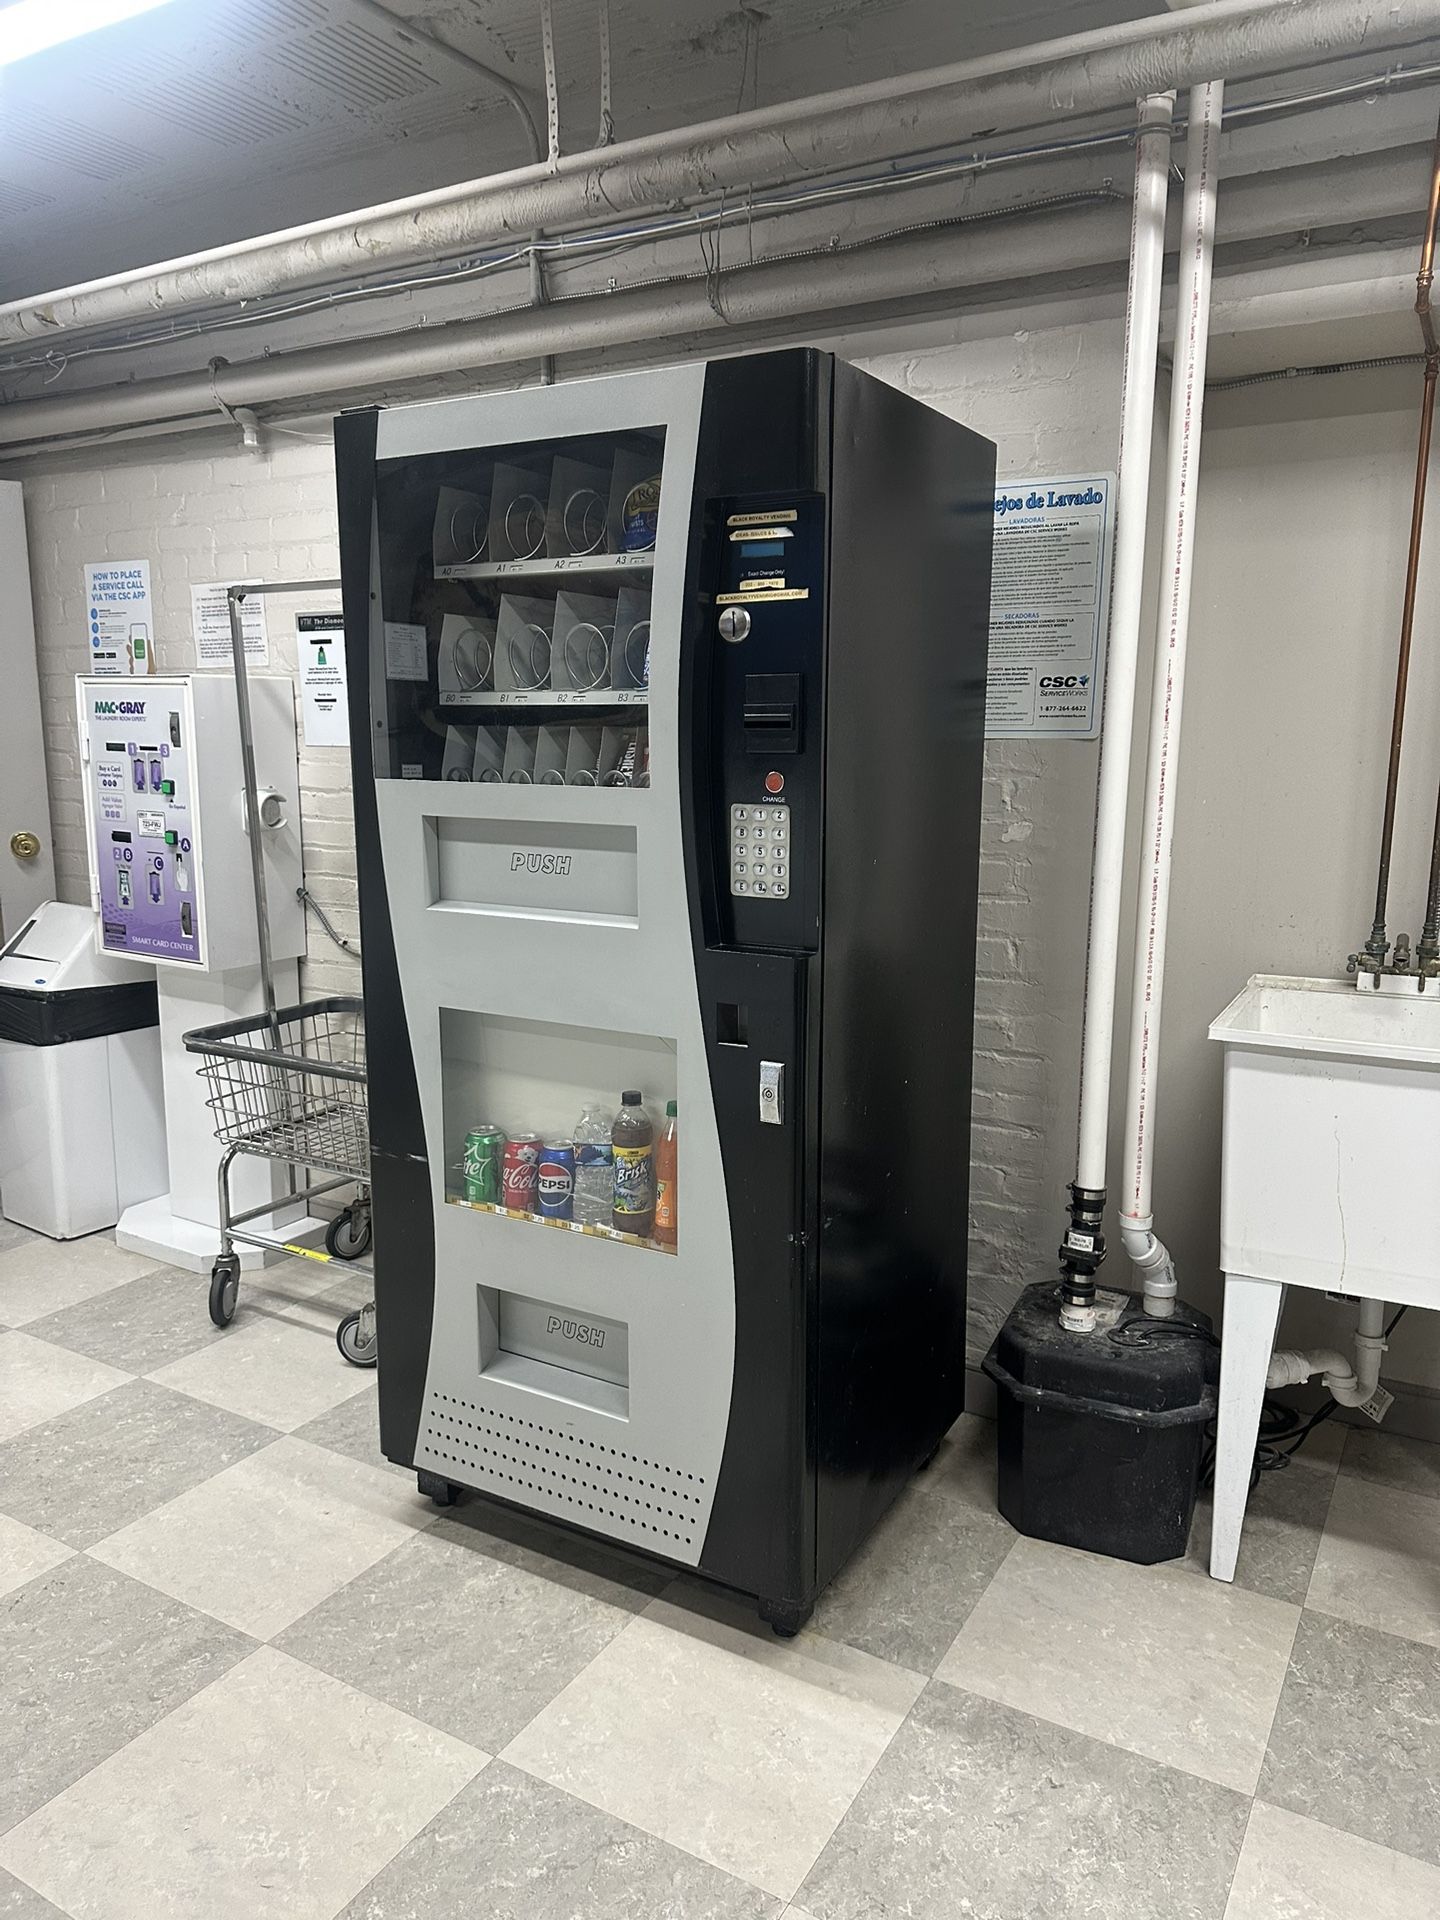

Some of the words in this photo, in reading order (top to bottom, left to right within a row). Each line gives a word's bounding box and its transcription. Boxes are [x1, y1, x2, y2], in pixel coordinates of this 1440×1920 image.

[1026, 492, 1045, 509] de
[1046, 487, 1103, 507] Lavado
[1009, 517, 1045, 525] LAVADORAS
[496, 564, 506, 573] A1
[554, 560, 565, 569] A2
[615, 556, 627, 565] A3
[93, 572, 109, 582] HOW
[110, 571, 119, 580] TO
[120, 570, 142, 580] PLACE
[92, 583, 97, 591] A
[98, 582, 125, 591] SERVICE
[126, 580, 144, 590] CALL
[91, 593, 103, 602] VIA
[104, 592, 117, 602] THE
[118, 592, 131, 601] CSC
[132, 591, 146, 600] APP
[1004, 612, 1040, 620] SECADORAS
[1039, 675, 1077, 688] CSC
[445, 694, 456, 703] B0
[500, 694, 510, 702] B1
[557, 694, 568, 703] B2
[617, 693, 628, 702] B3
[130, 744, 135, 754] 1
[162, 745, 168, 755] 3
[98, 765, 107, 774] Buy
[110, 765, 121, 773] Card
[762, 795, 786, 803] CHANGE
[739, 810, 745, 818] A
[758, 829, 763, 837] 3
[182, 840, 190, 850] A
[114, 849, 120, 858] 2
[125, 850, 132, 860] B
[155, 858, 162, 868] C
[510, 852, 572, 875] PUSH
[758, 865, 763, 873] 7
[777, 866, 782, 874] 8
[131, 936, 151, 946] SMART
[152, 939, 170, 949] CARD
[170, 941, 194, 952] CENTER
[617, 1161, 648, 1184] Brisk
[547, 1316, 606, 1348] PUSH
